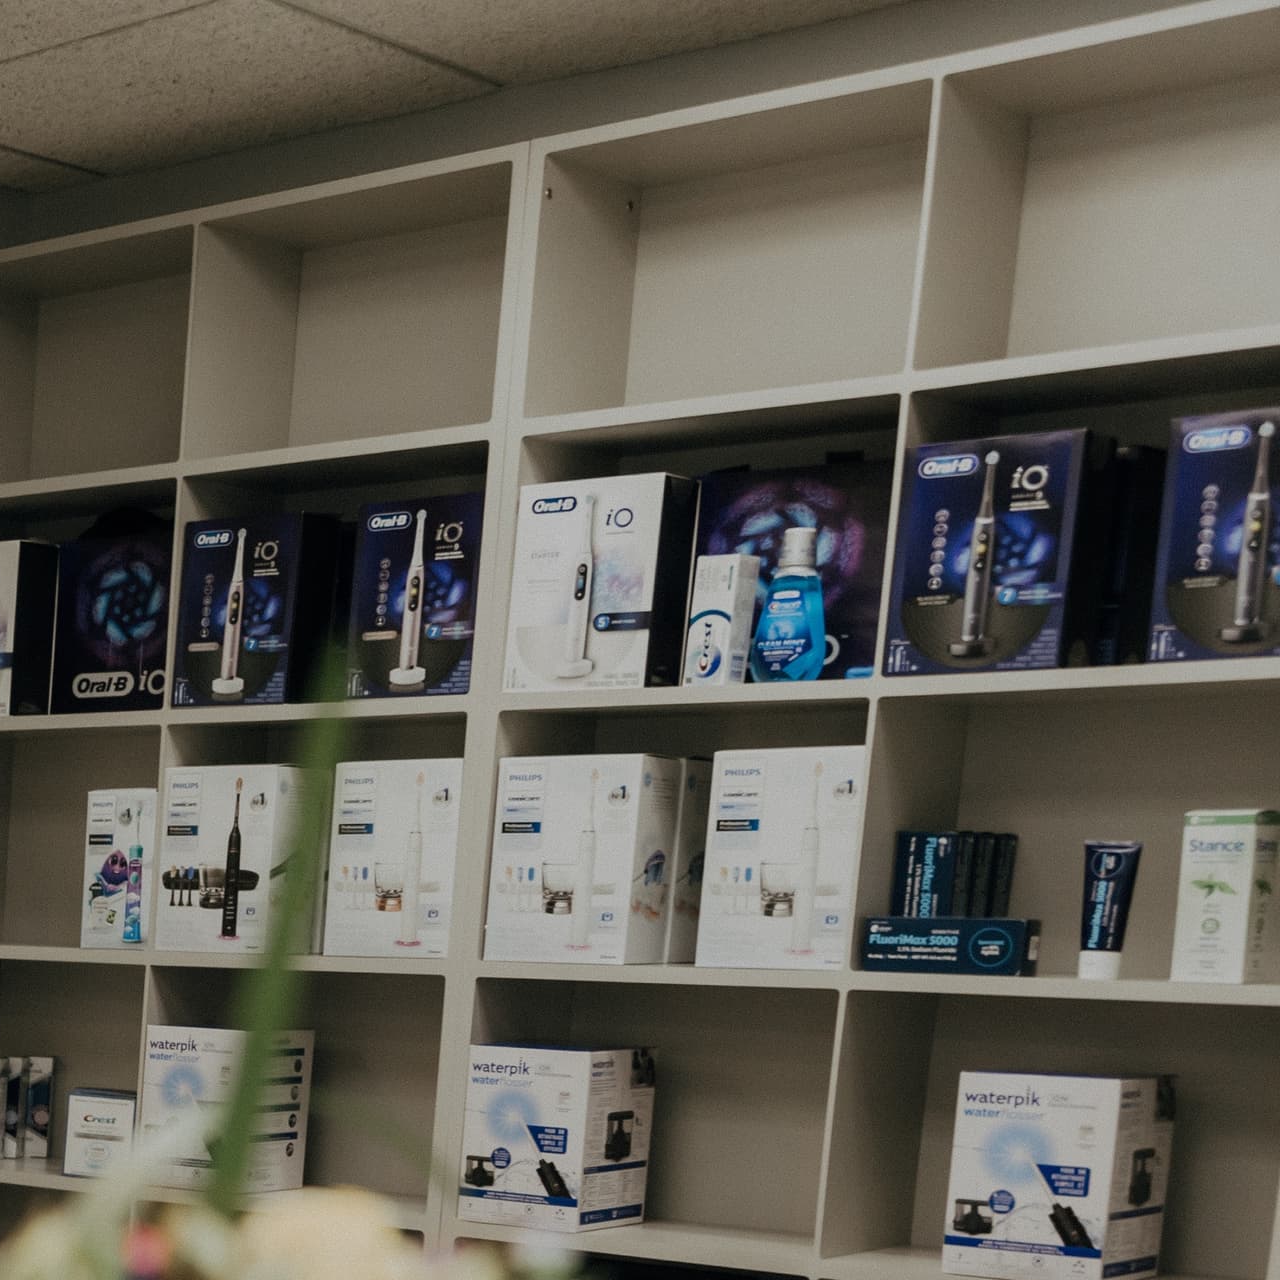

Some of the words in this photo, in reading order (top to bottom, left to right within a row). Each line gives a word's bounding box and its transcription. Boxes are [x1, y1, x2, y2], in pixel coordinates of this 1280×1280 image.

[922, 457, 975, 475] Oral-B
[534, 497, 575, 513] Oral-B
[370, 514, 408, 529] Oral-B
[605, 507, 634, 528] iO
[197, 531, 229, 546] Oral-B
[77, 676, 128, 693] Oral-B
[1190, 839, 1245, 853] Stance
[869, 934, 927, 945] FluoriMax
[928, 935, 959, 946] 5000
[150, 1034, 198, 1053] waterpik
[472, 1057, 531, 1076] waterpik
[965, 1086, 1040, 1108] waterpik
